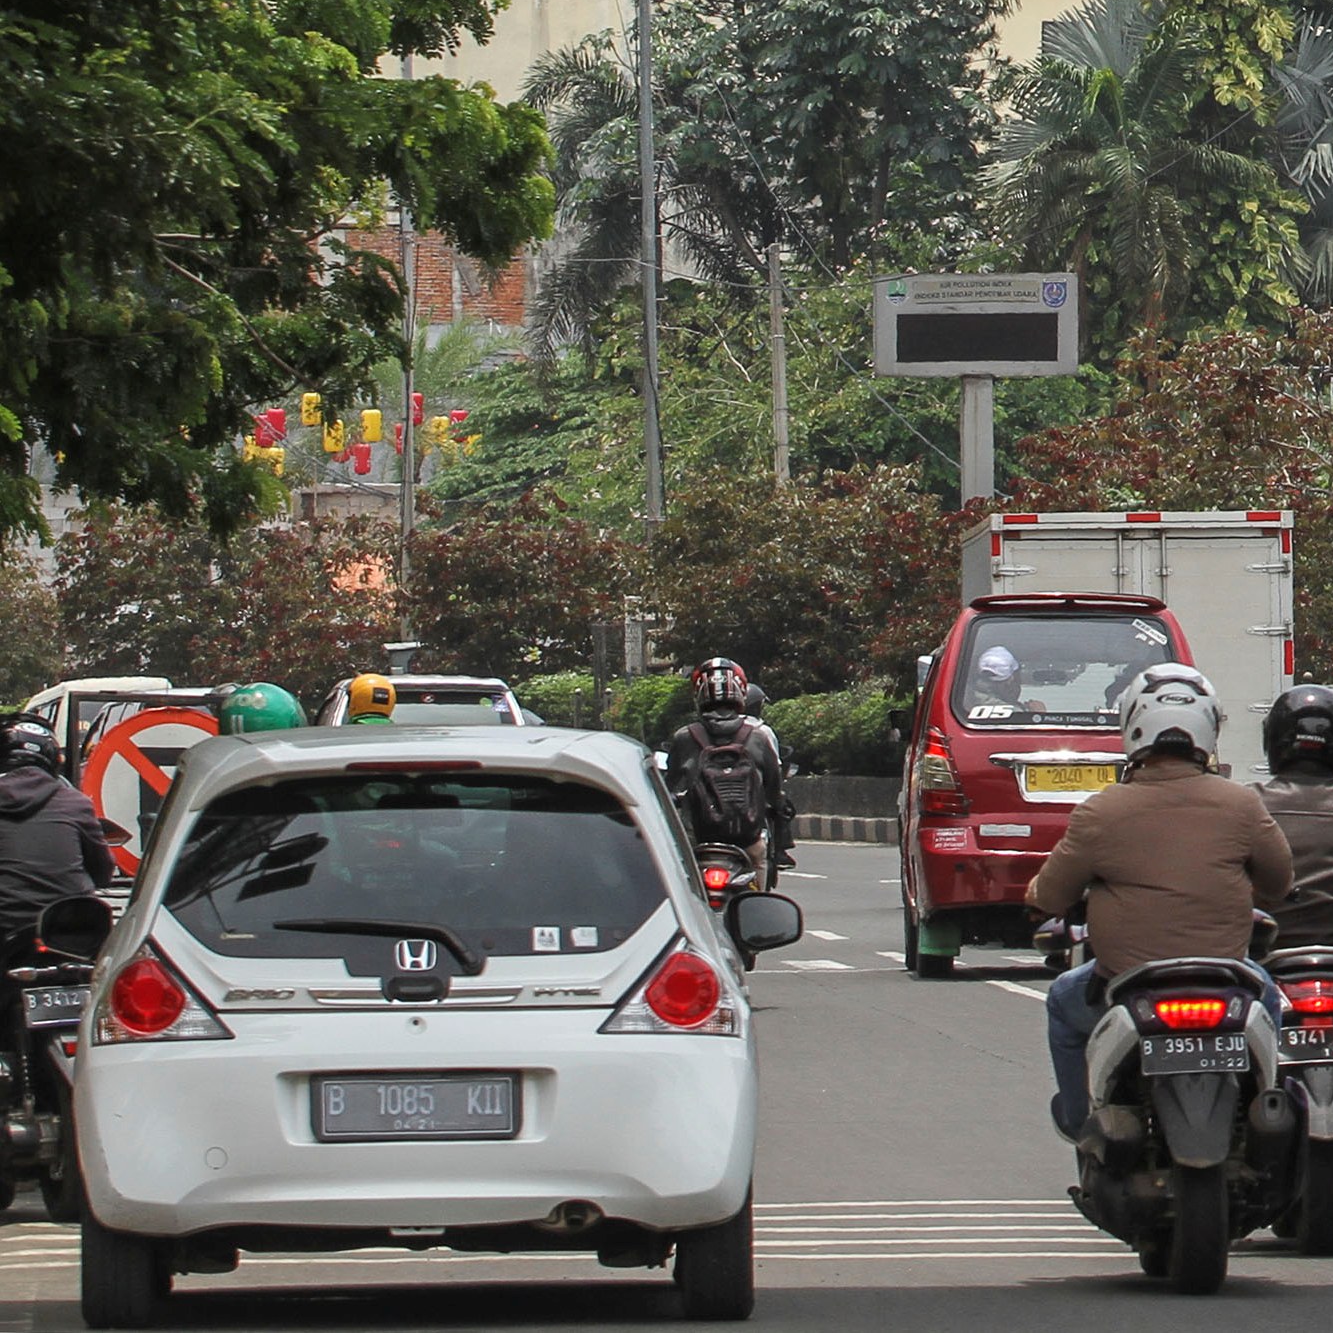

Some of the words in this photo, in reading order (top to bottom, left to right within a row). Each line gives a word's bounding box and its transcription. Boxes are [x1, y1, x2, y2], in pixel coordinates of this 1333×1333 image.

[968, 704, 1015, 720] 05
[28, 994, 37, 1009] B
[1143, 1040, 1153, 1056] B
[1165, 1037, 1204, 1053] 3951
[1215, 1036, 1245, 1052] EJU
[328, 1084, 346, 1116] B
[377, 1084, 435, 1116] 1085
[467, 1083, 504, 1115] KII
